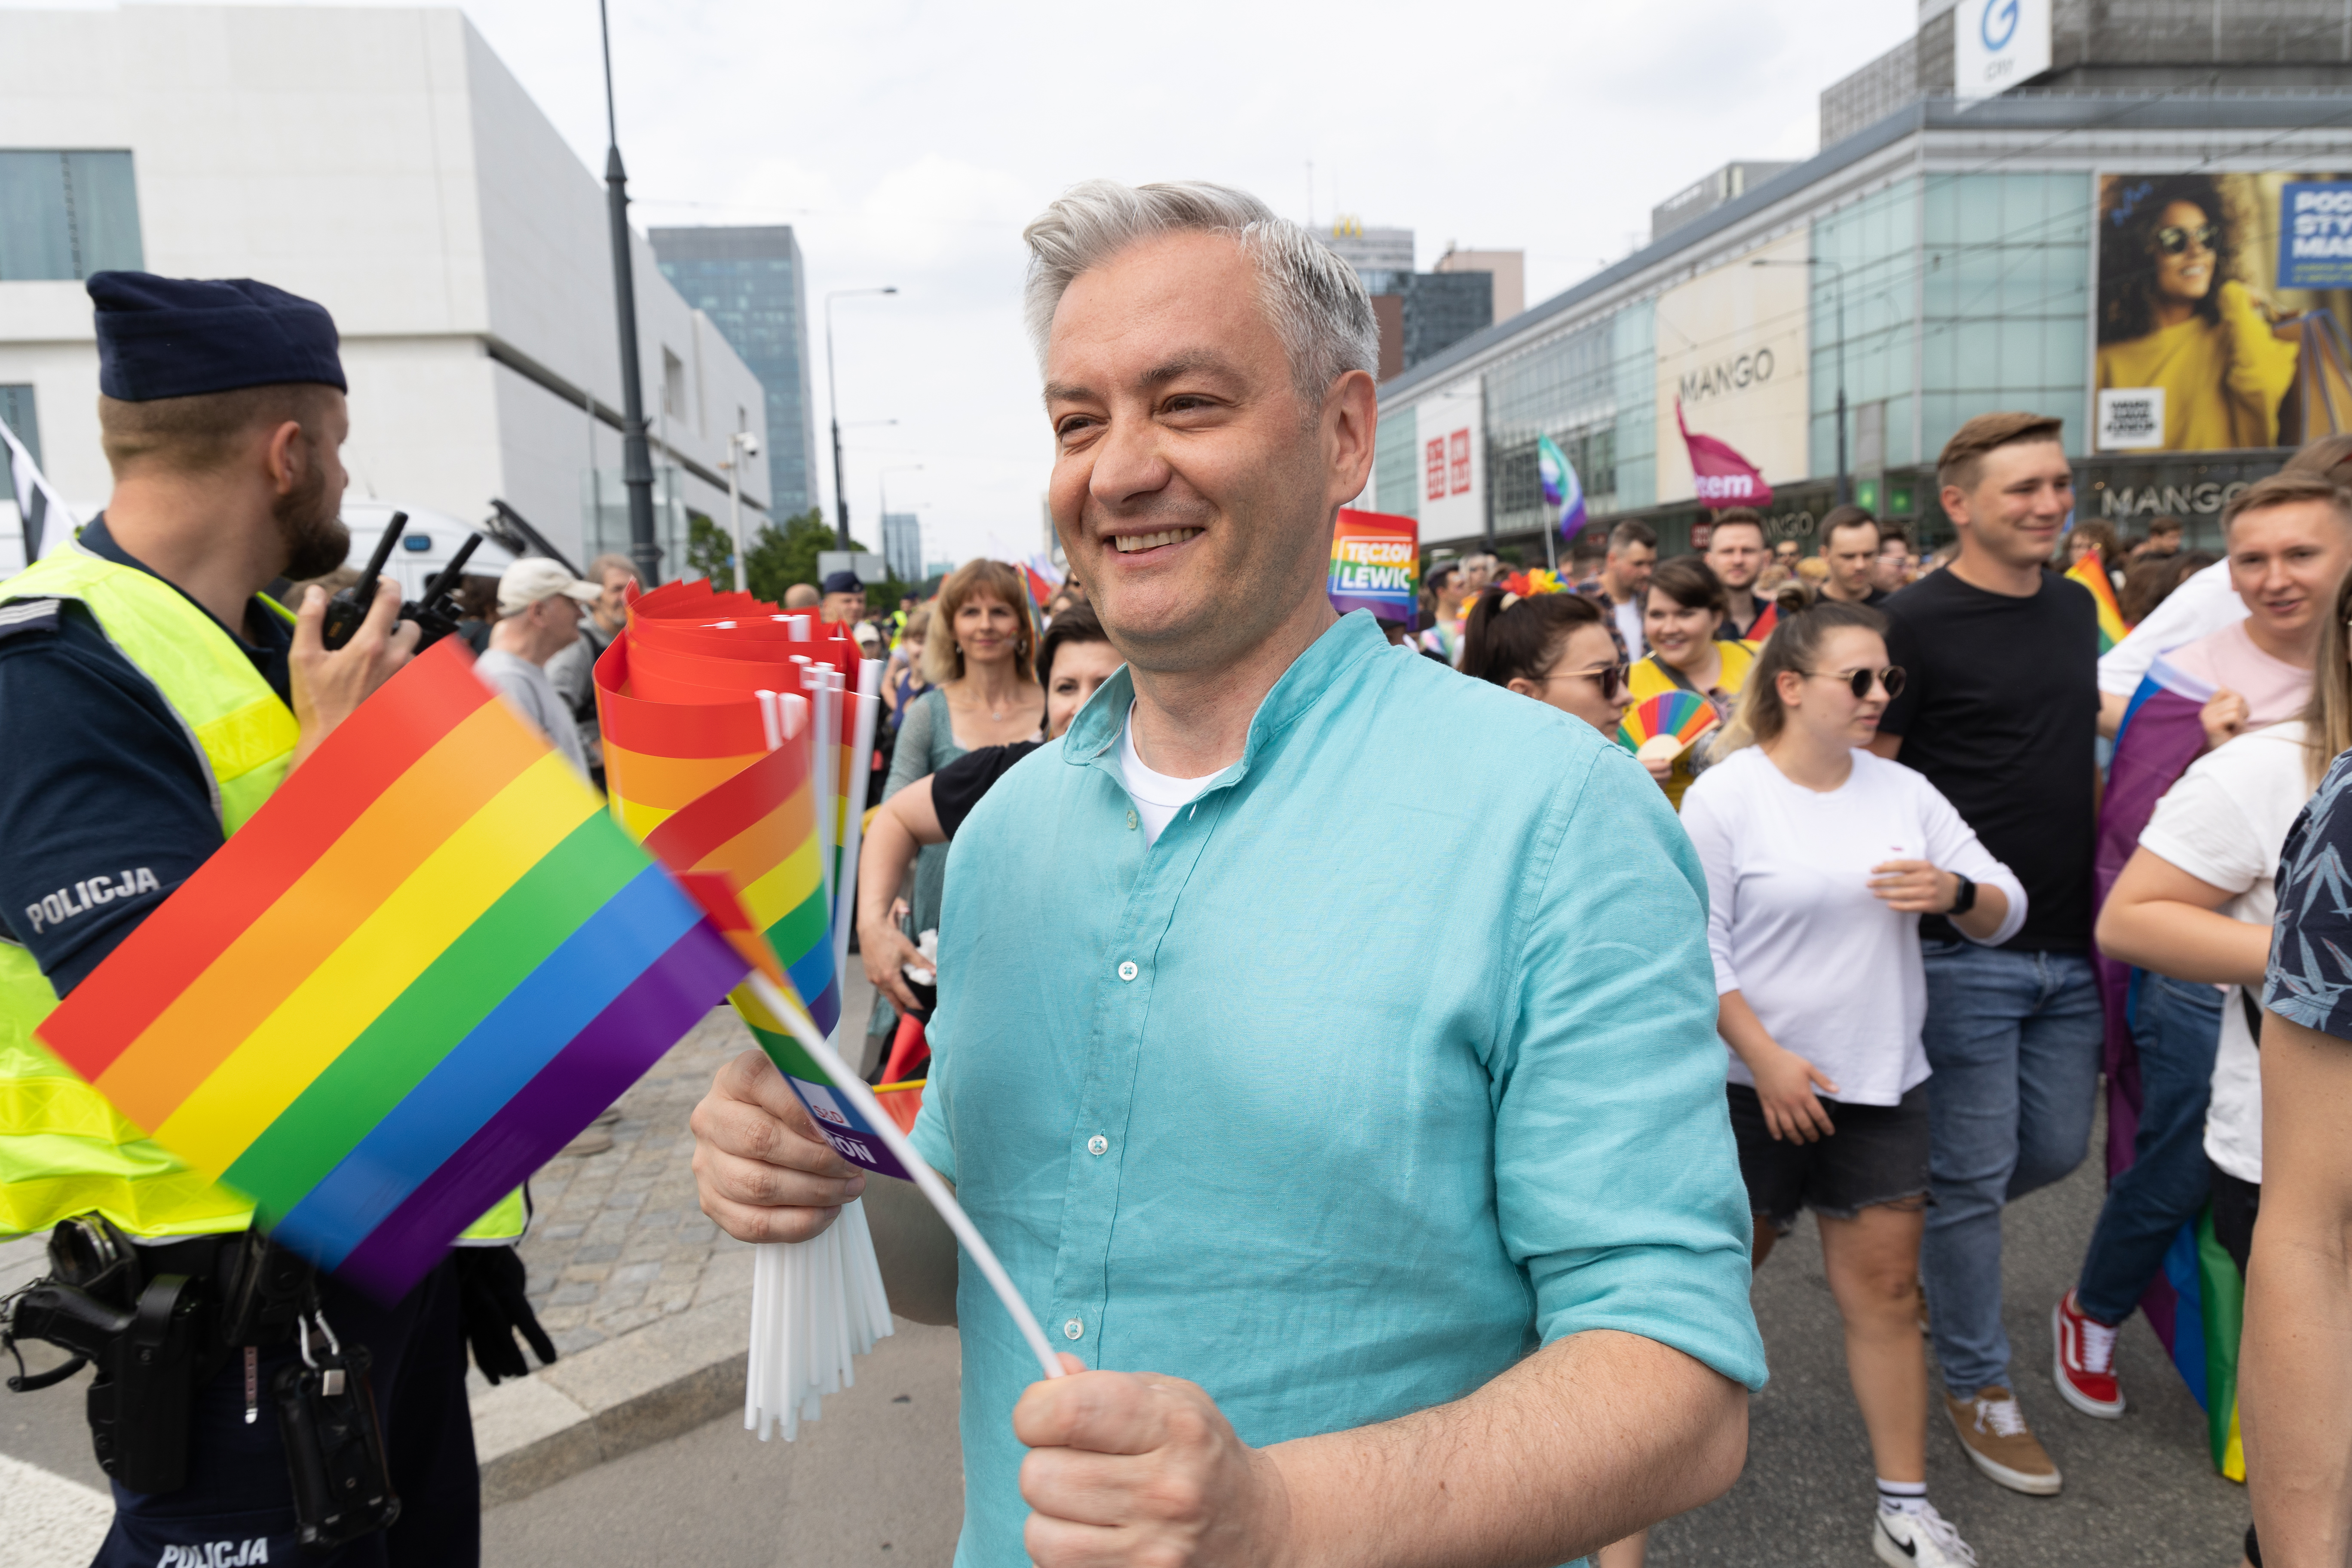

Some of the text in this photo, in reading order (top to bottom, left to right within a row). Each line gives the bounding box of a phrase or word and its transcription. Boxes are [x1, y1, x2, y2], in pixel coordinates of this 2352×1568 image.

[1678, 347, 1775, 402] MANGO
[1341, 566, 1411, 590] LEWIC
[25, 867, 161, 934] POLICJA
[812, 1104, 845, 1124] S&D
[156, 1537, 269, 1568] POLICJA
